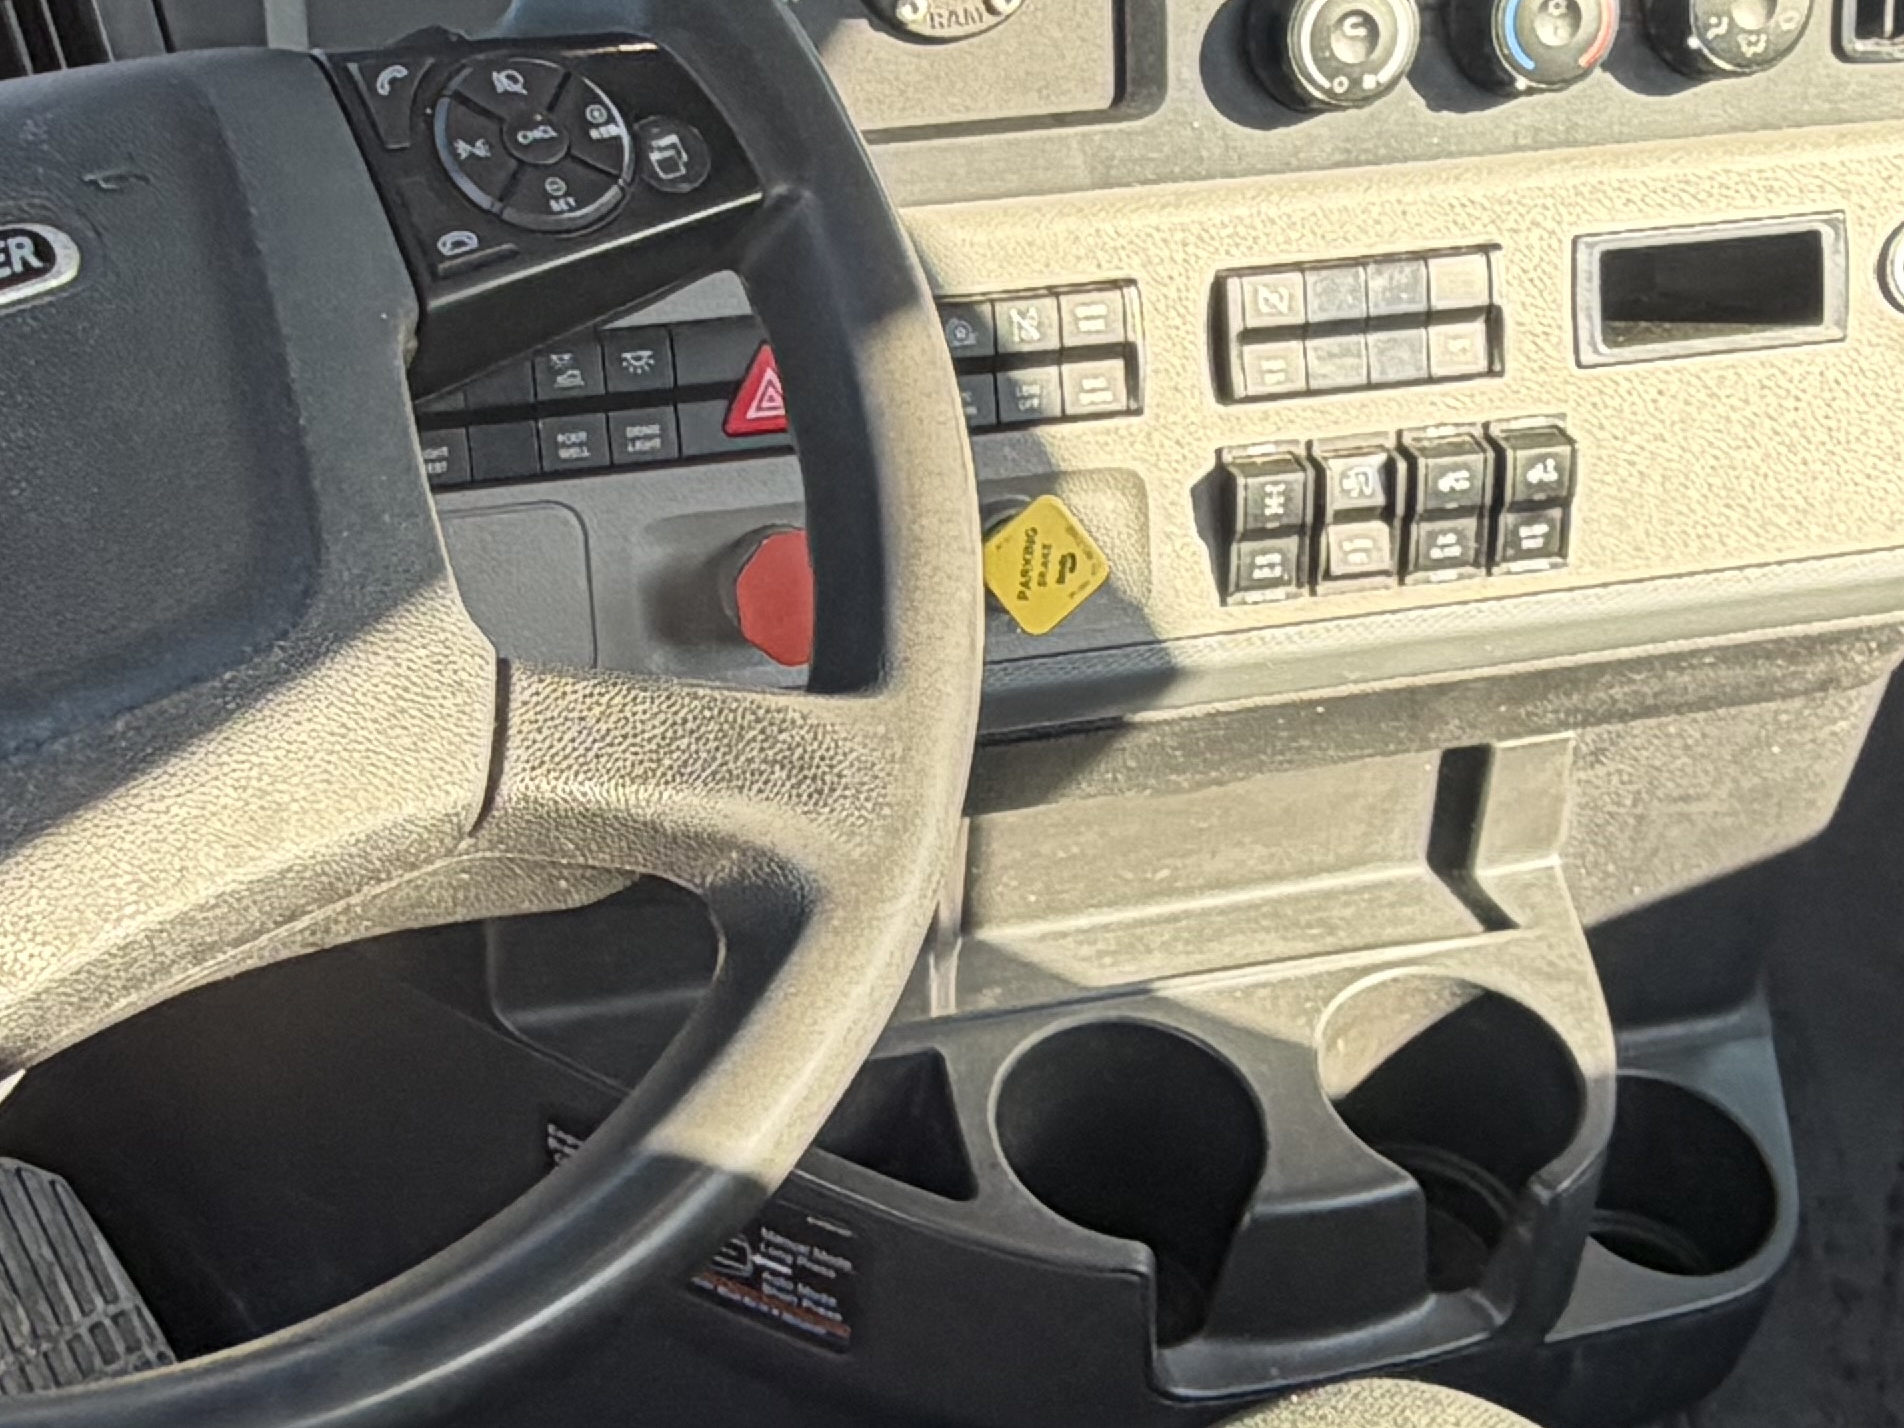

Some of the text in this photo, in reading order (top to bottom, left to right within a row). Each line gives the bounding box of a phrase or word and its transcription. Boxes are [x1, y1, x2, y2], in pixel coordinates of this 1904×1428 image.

[928, 6, 985, 30] RAM
[1016, 525, 1039, 602] PARKING
[1036, 542, 1053, 588] BRAKE
